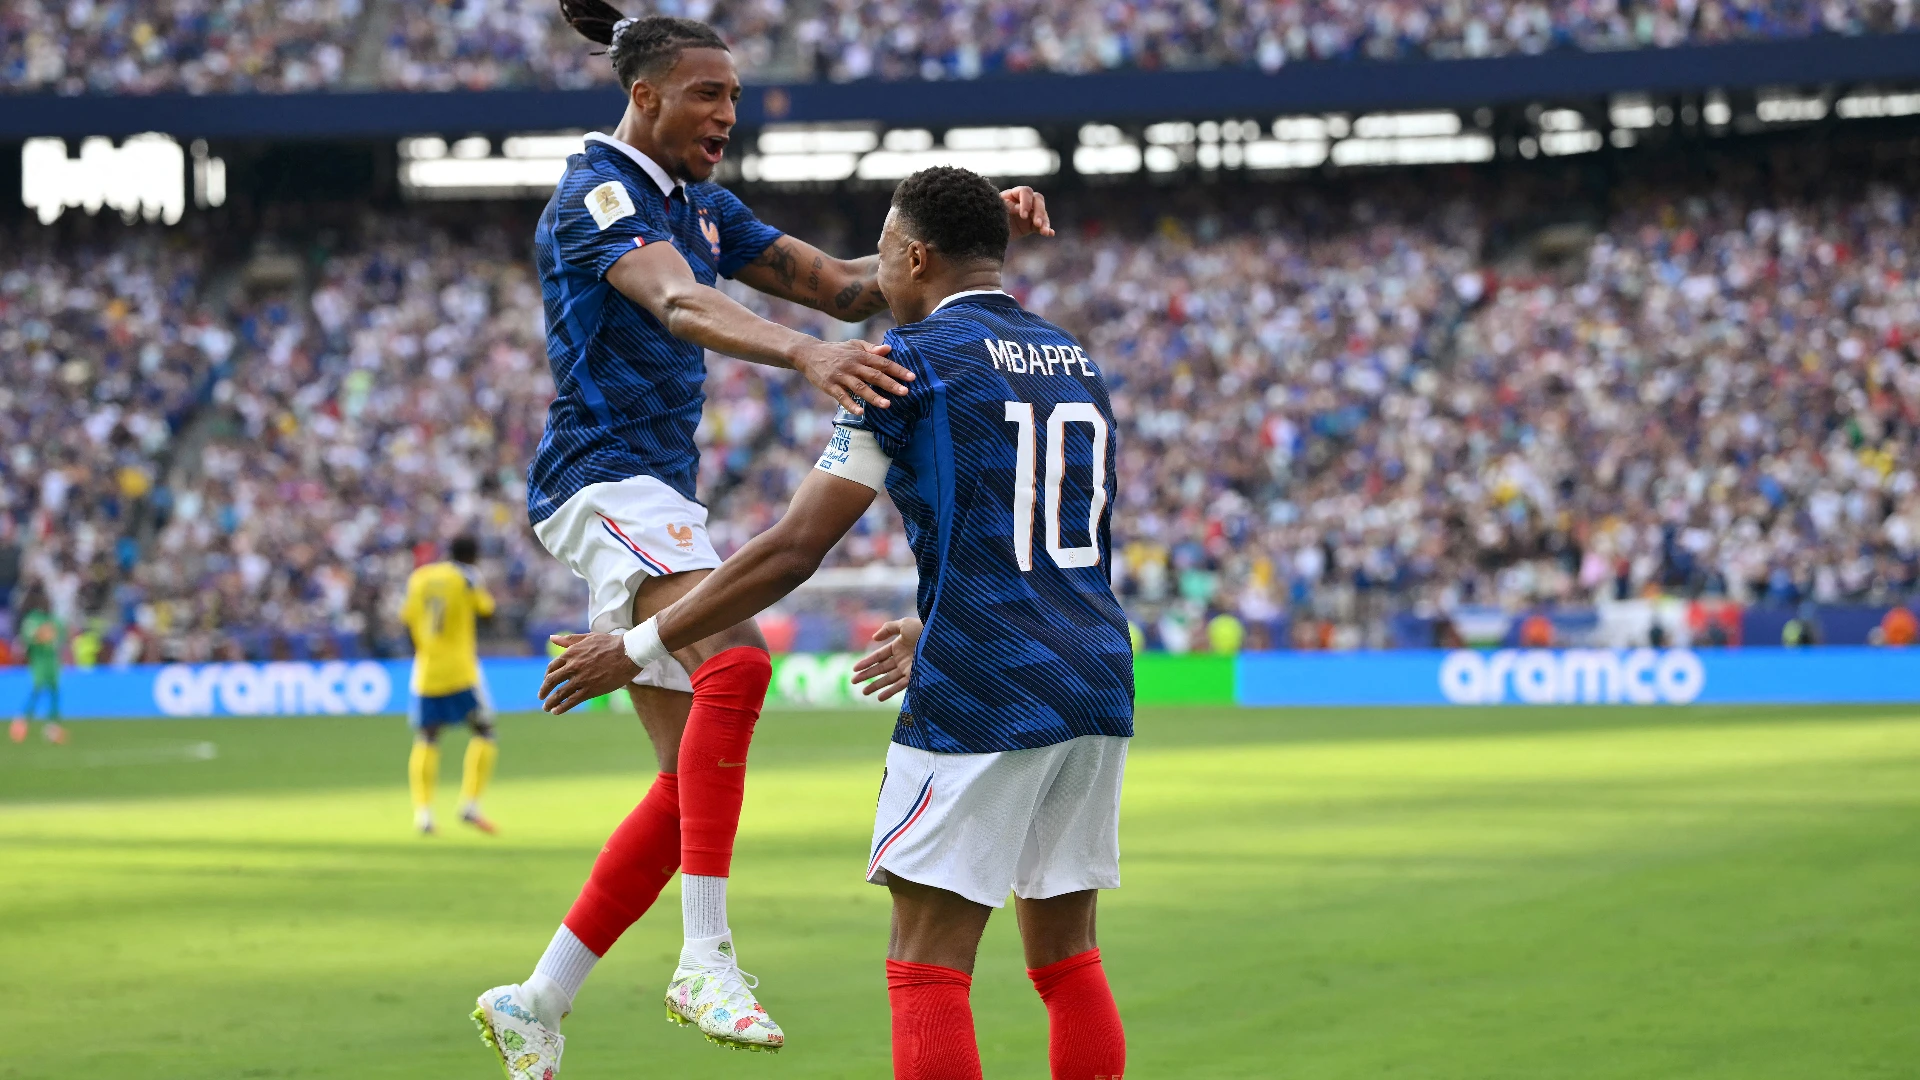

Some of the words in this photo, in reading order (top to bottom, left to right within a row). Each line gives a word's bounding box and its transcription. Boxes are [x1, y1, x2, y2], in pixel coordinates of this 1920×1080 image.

[984, 338, 1095, 377] MBAPPE
[1005, 400, 1109, 571] 10
[154, 661, 391, 715] aramco
[1439, 648, 1705, 705] aramco
